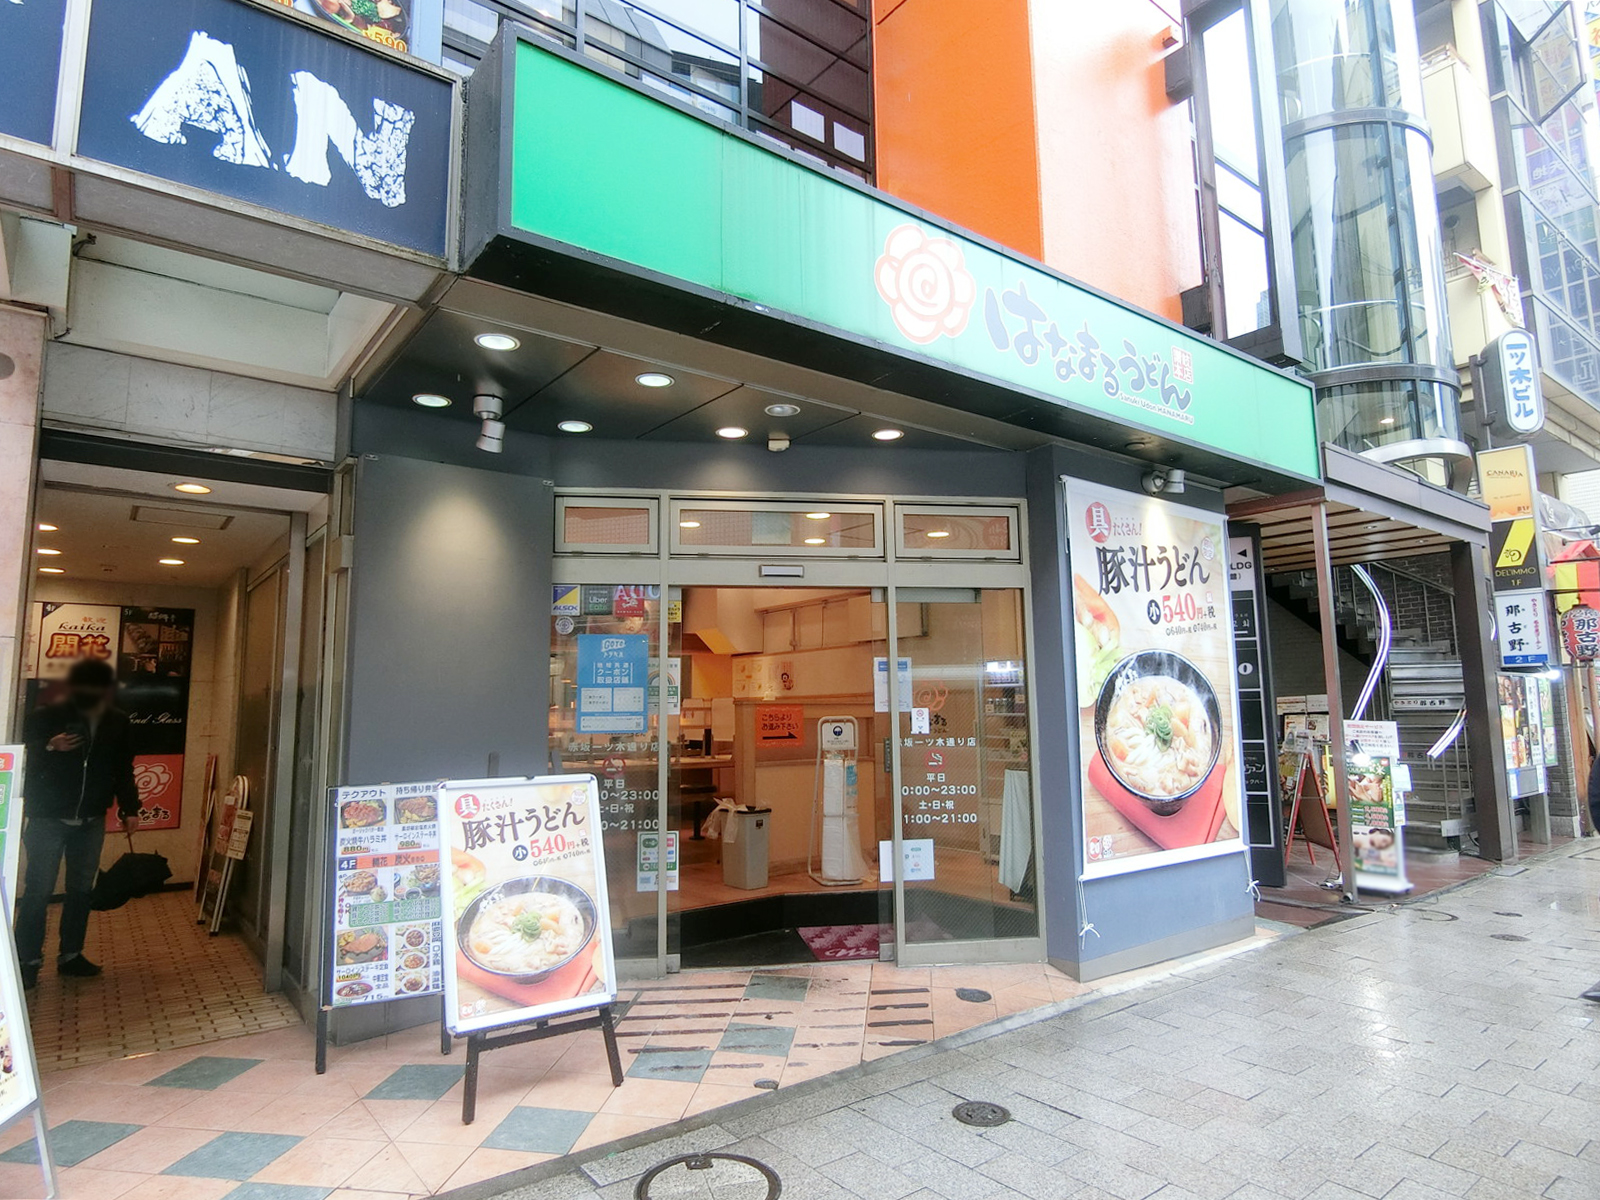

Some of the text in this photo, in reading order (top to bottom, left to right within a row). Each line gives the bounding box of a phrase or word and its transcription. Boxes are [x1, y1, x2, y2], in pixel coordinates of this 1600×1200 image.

[984, 280, 1191, 411] はなまるうどん
[1506, 343, 1534, 418] 一ツ木ビル
[1090, 506, 1109, 537] 具
[1095, 545, 1210, 596] 豚汁うどん
[589, 596, 607, 604] Uber
[1148, 601, 1160, 622] 小
[58, 622, 107, 632] kaika
[1505, 604, 1524, 651] 那古野
[46, 633, 111, 659] 開花
[1574, 618, 1599, 657] 那古野
[762, 713, 792, 722] こちらより
[568, 742, 659, 752] 赤坂一ツ木通り店
[900, 737, 977, 747] 坂一ツ木通り店
[604, 779, 625, 789] 平日
[926, 773, 945, 782] 平日
[459, 796, 478, 816] 具
[462, 802, 585, 852] 豚汁うどん
[514, 846, 527, 860] 小
[341, 860, 357, 869] 4F
